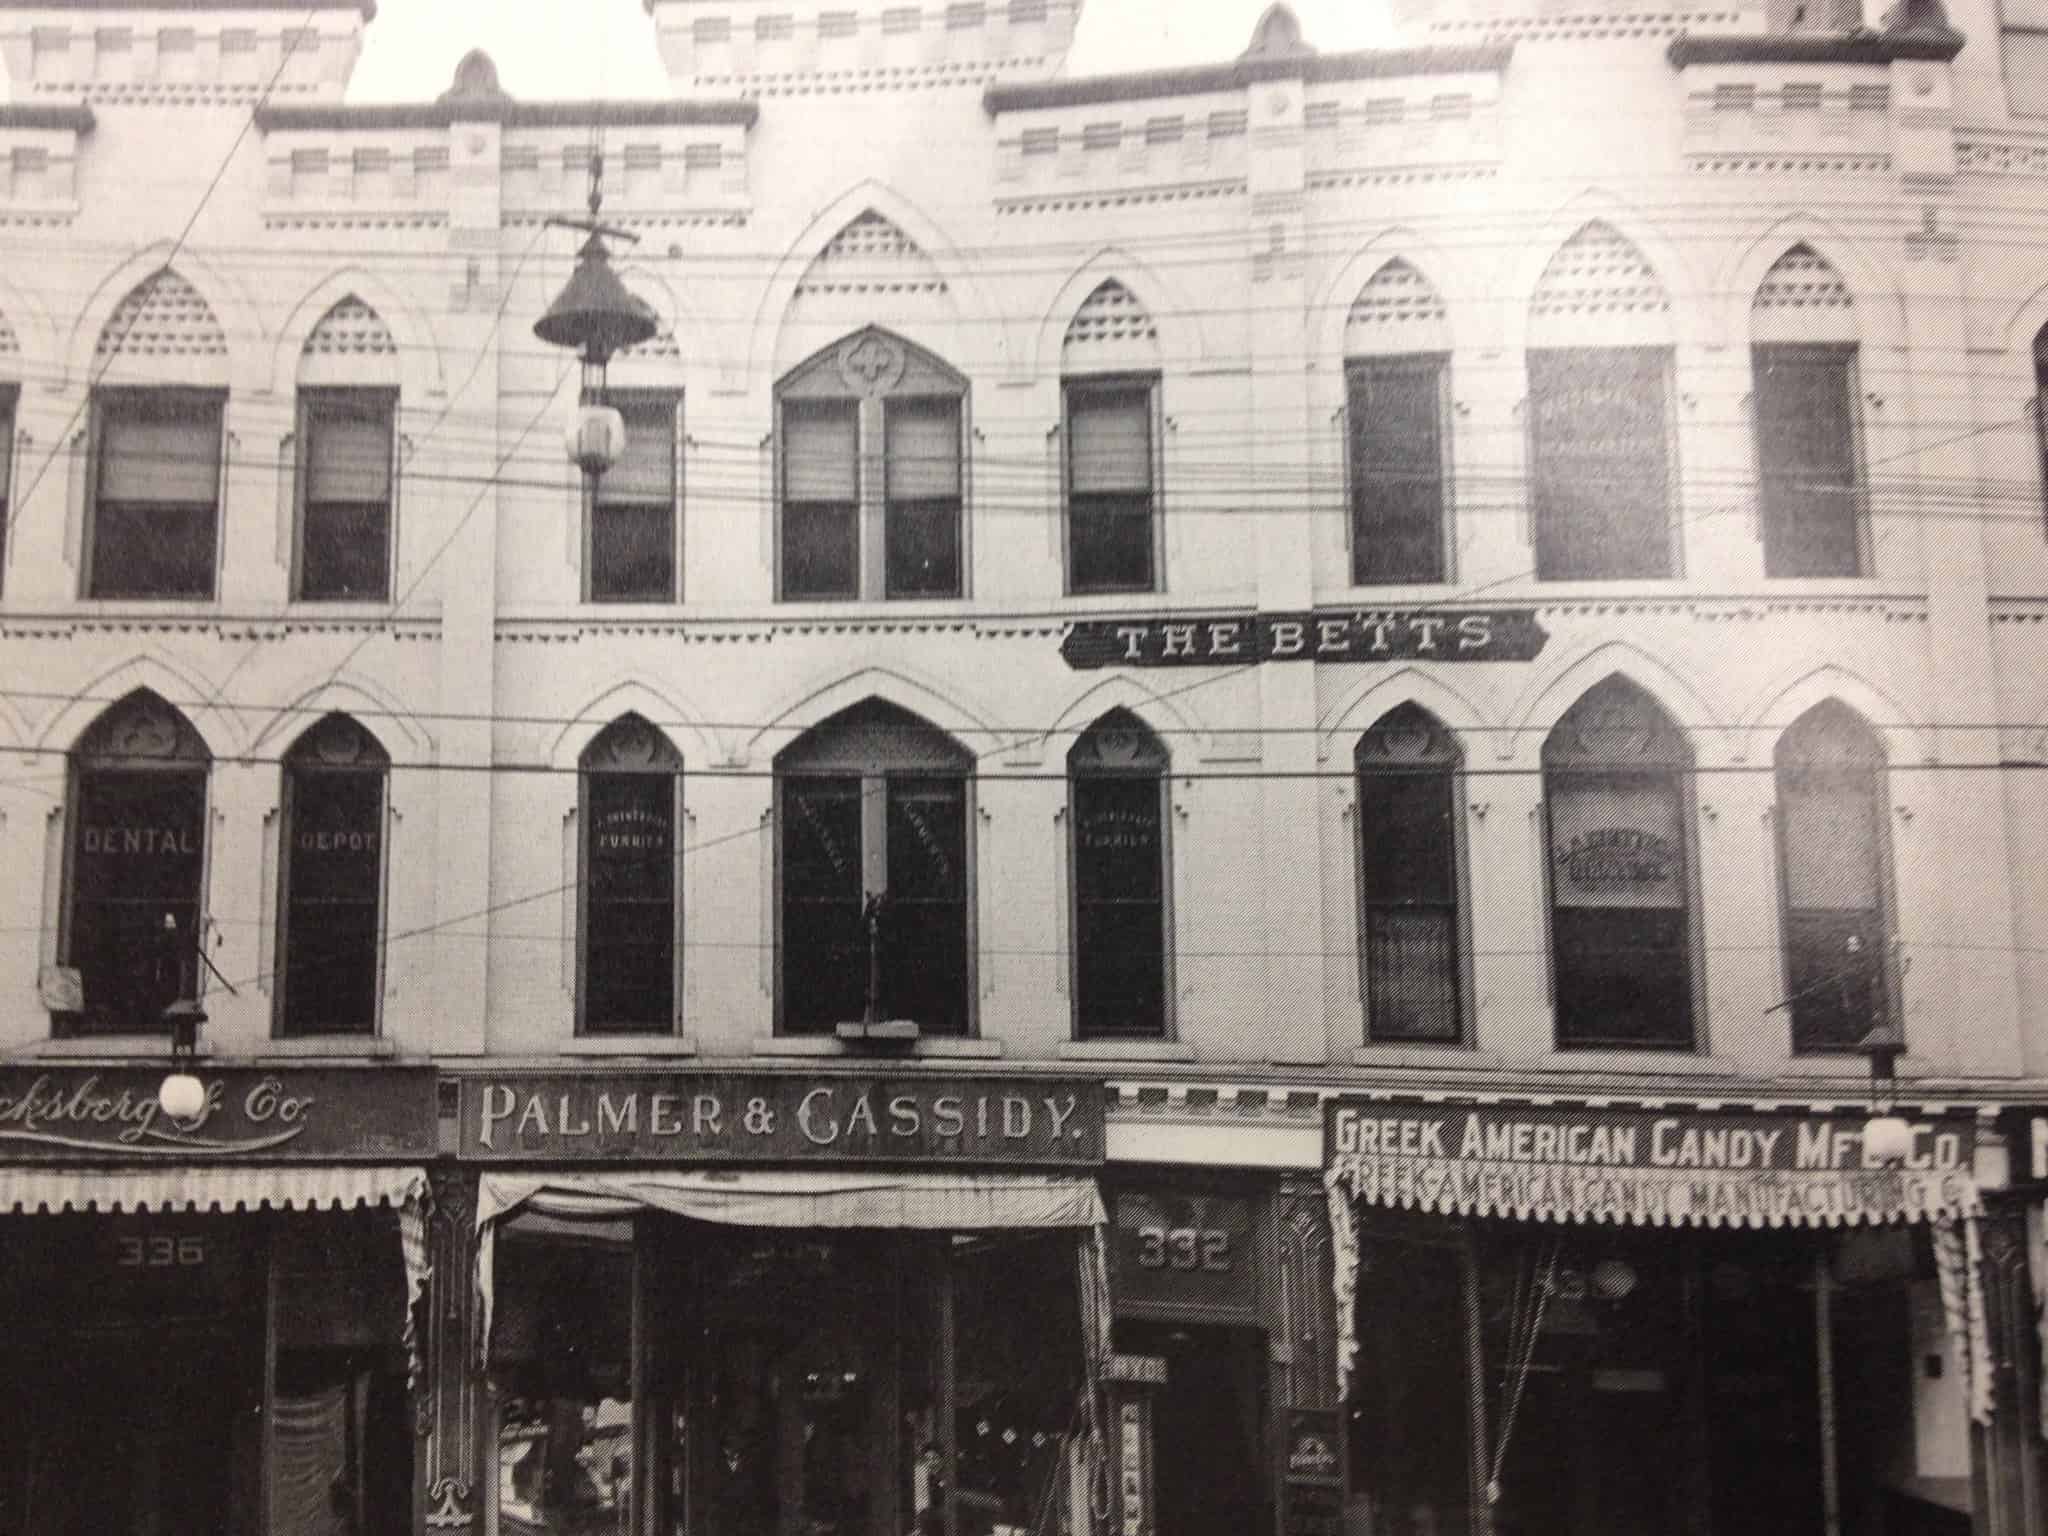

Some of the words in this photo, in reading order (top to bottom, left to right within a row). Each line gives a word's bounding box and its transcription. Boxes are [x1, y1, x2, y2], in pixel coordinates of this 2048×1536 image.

[1117, 622, 1241, 658] THE
[1271, 614, 1493, 656] BETTS
[84, 825, 198, 854] DENTAL
[300, 829, 377, 851] DEPOT
[480, 1085, 723, 1149] PALMER
[743, 1096, 776, 1136] &
[1336, 1109, 1444, 1155] GREEK
[1461, 1113, 1637, 1164] AMERICAN
[1651, 1119, 1783, 1169] CANDY
[117, 1236, 205, 1266] 336
[1138, 1227, 1230, 1271] 332
